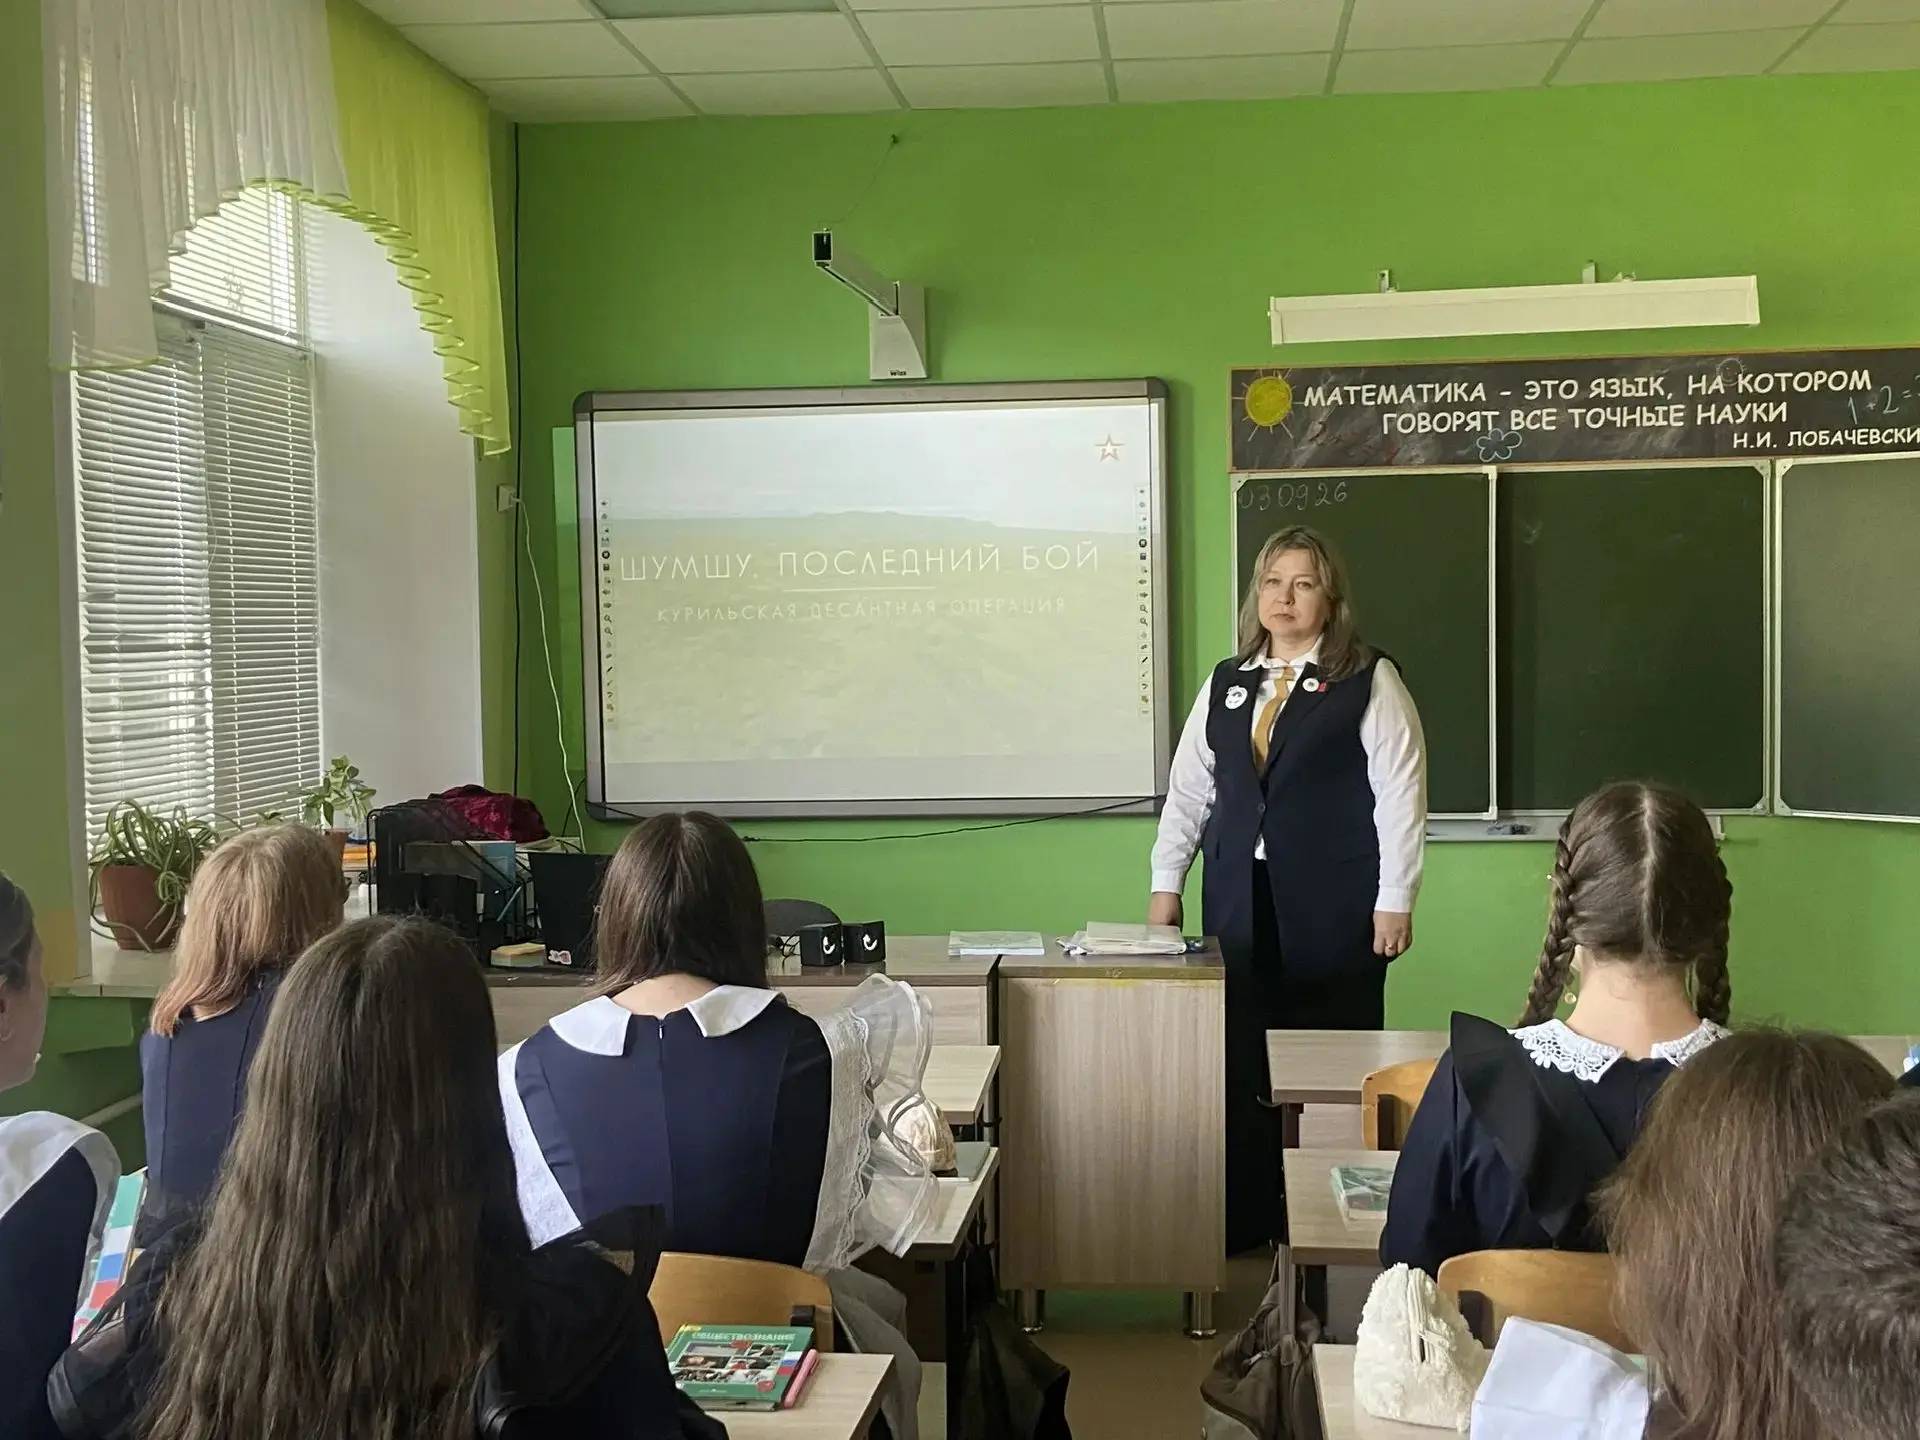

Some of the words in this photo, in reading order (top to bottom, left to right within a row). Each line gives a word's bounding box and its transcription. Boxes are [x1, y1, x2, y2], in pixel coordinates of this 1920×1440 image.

[1304, 382, 1487, 407] МАТЕМАТИКА
[1524, 379, 1578, 400] ЭТО
[1589, 376, 1674, 400] ЯЗЫК,
[1687, 375, 1725, 396] НА
[1738, 369, 1872, 394] КОТОРОМ
[1382, 411, 1500, 434] ГОВОРЯТ
[1510, 408, 1557, 431] ВСЕ
[1569, 404, 1685, 429] ТОЧНЫЕ
[1696, 402, 1787, 425] НАУКИ
[1733, 430, 1777, 449] Н.И.
[620, 553, 758, 581] ШУМШУ.
[780, 543, 1000, 576] ПОСЛЕДНИЙ
[1023, 540, 1098, 571] БОЙ
[658, 603, 796, 622] КУРИЛЬСКАЯ
[811, 601, 936, 619] ДЕСАНТНАЯ
[951, 597, 1065, 615] ОПЕРАЦИЯ
